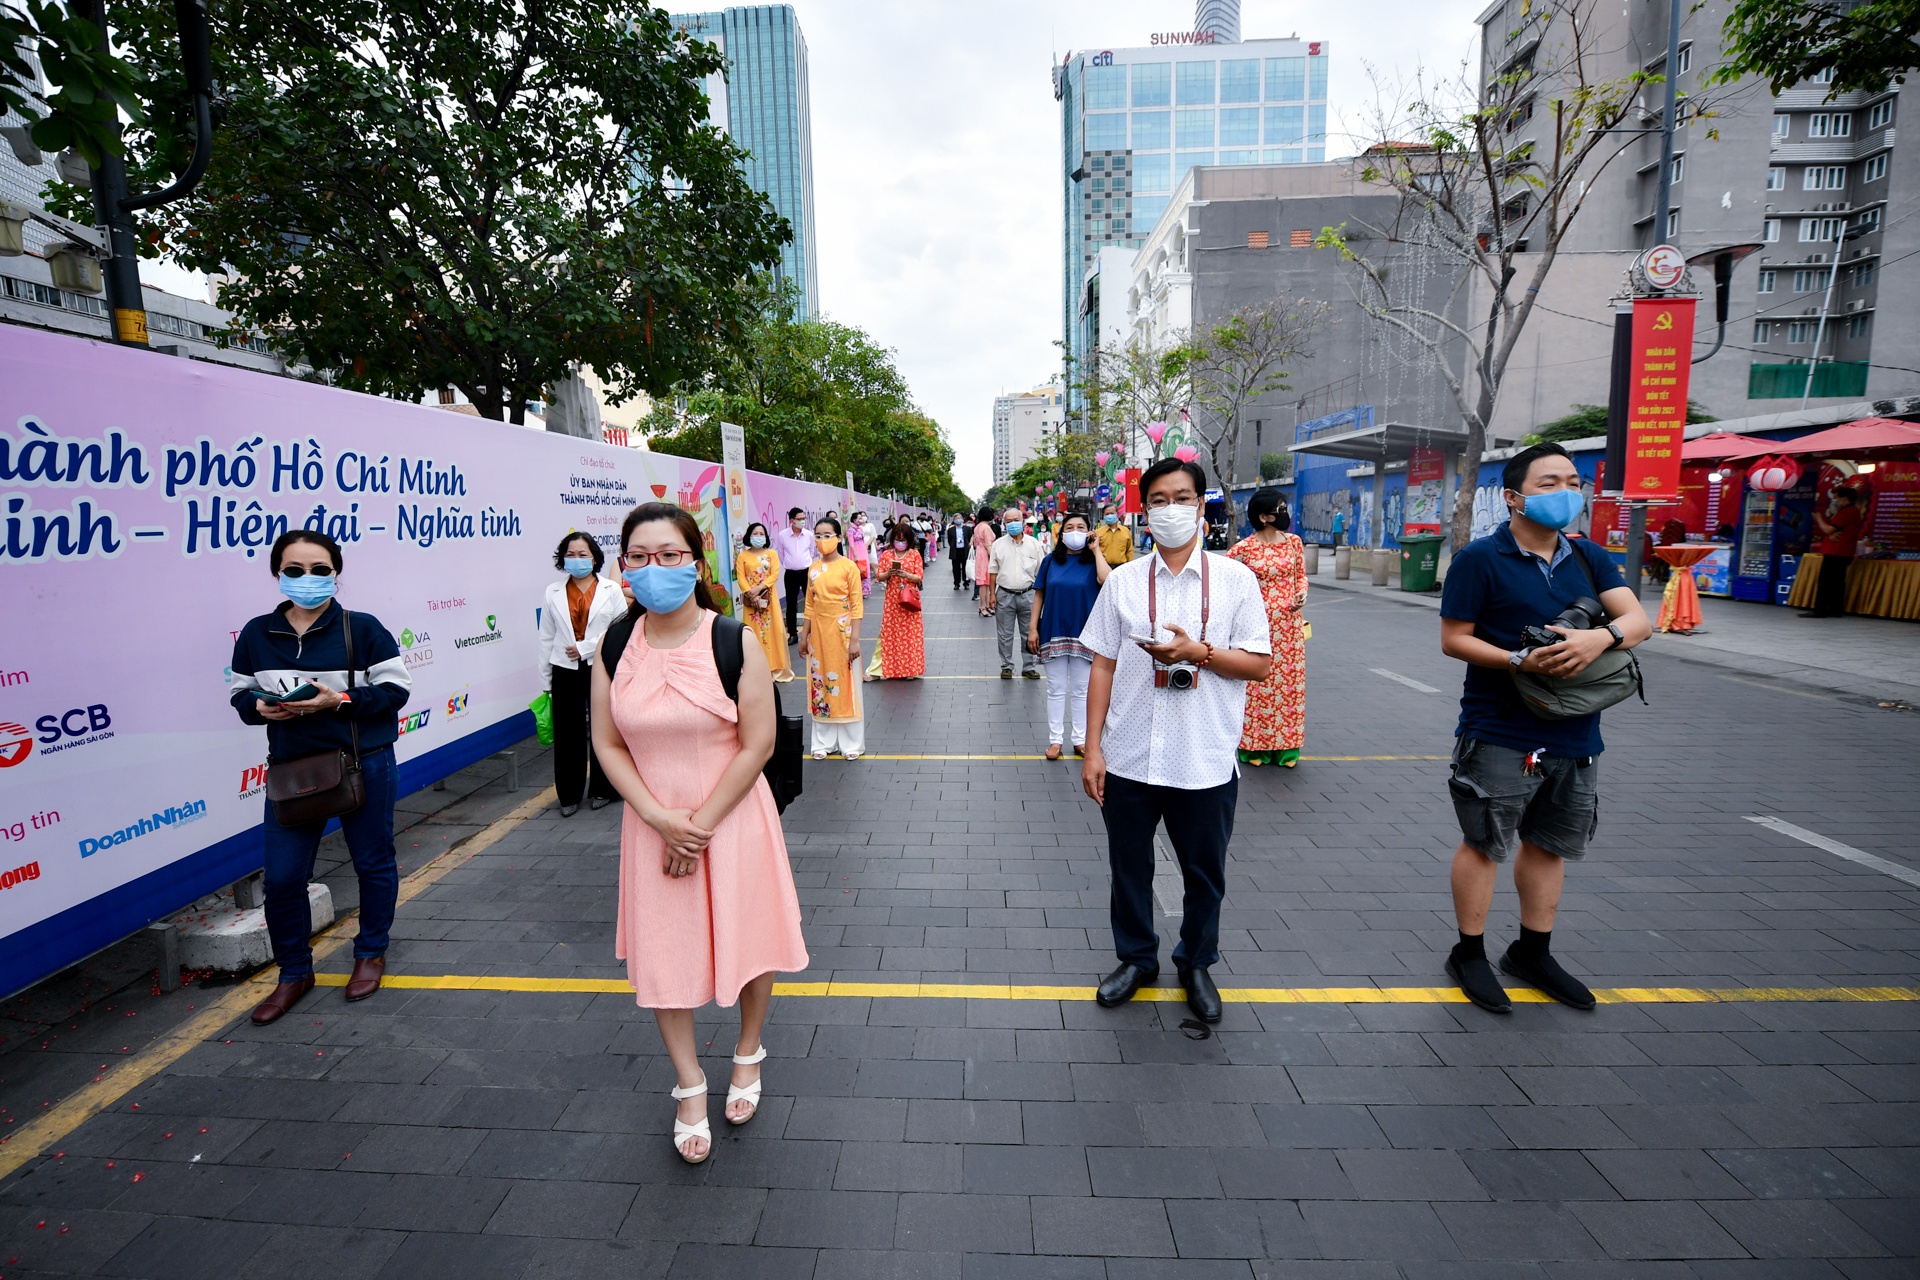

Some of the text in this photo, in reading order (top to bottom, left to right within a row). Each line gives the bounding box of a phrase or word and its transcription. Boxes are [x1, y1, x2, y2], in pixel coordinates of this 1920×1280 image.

[1151, 30, 1215, 46] SUNWAH
[1092, 51, 1113, 66] citi
[1646, 347, 1676, 356] NHÂN DÂN
[1644, 360, 1676, 371] THÀNH PHỐ
[1641, 376, 1677, 386] HỒ CHÍ MINH
[1659, 390, 1669, 400] TẾT
[1638, 406, 1649, 415] TÂN
[1638, 435, 1670, 445] LÀNH MẠNH
[166, 437, 263, 497] phố
[272, 439, 324, 492] Hồ
[336, 452, 390, 493] Chí
[399, 458, 466, 496] Minh
[570, 473, 627, 491] ỦY BAN NHÂN DÂN
[560, 491, 636, 506] THÀNH PHỐ HỒ CHÍ MINH
[0, 498, 120, 558] inh
[187, 496, 287, 557] Hiện
[304, 503, 361, 551] đại
[398, 504, 475, 547] Nghĩa
[481, 506, 521, 537] tình
[428, 597, 466, 611] Tài trợ bạc
[454, 629, 503, 649] Vietcombank
[403, 649, 434, 666] AND
[35, 703, 112, 744] SCB
[398, 709, 430, 735] HTV
[40, 731, 115, 756] NGÂN HÀNG SÀI GÒN
[238, 787, 261, 801] THÀNH
[31, 810, 61, 830] tin
[78, 799, 207, 858] DoanhNhân
[0, 861, 41, 890] ộng
